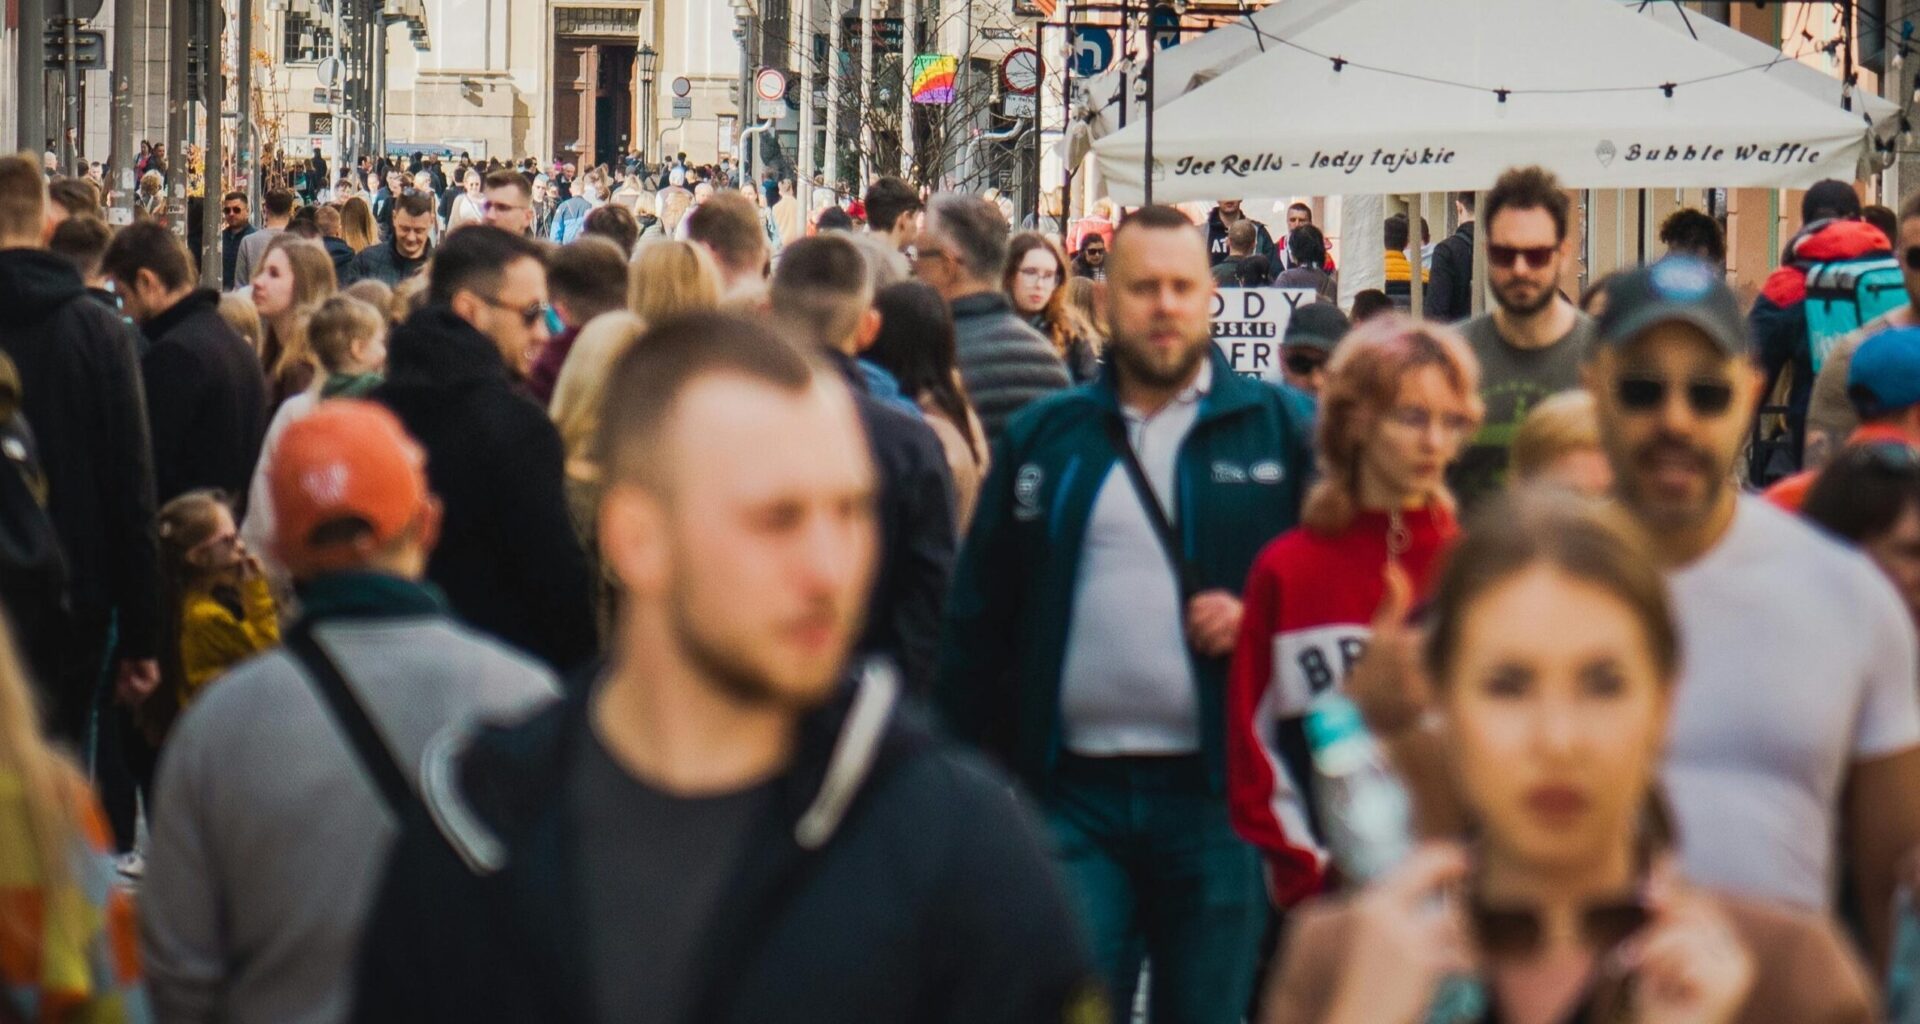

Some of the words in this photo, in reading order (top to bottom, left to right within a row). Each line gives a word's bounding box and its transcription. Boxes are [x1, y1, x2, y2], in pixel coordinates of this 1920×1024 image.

[1174, 155, 1213, 176] Ice
[1220, 153, 1284, 178] Rolls
[1309, 150, 1363, 174] lody
[1370, 147, 1456, 174] tajskie
[1624, 143, 1724, 162] Bubble
[1734, 142, 1821, 165] Waffle
[1208, 322, 1275, 336] JSKIE
